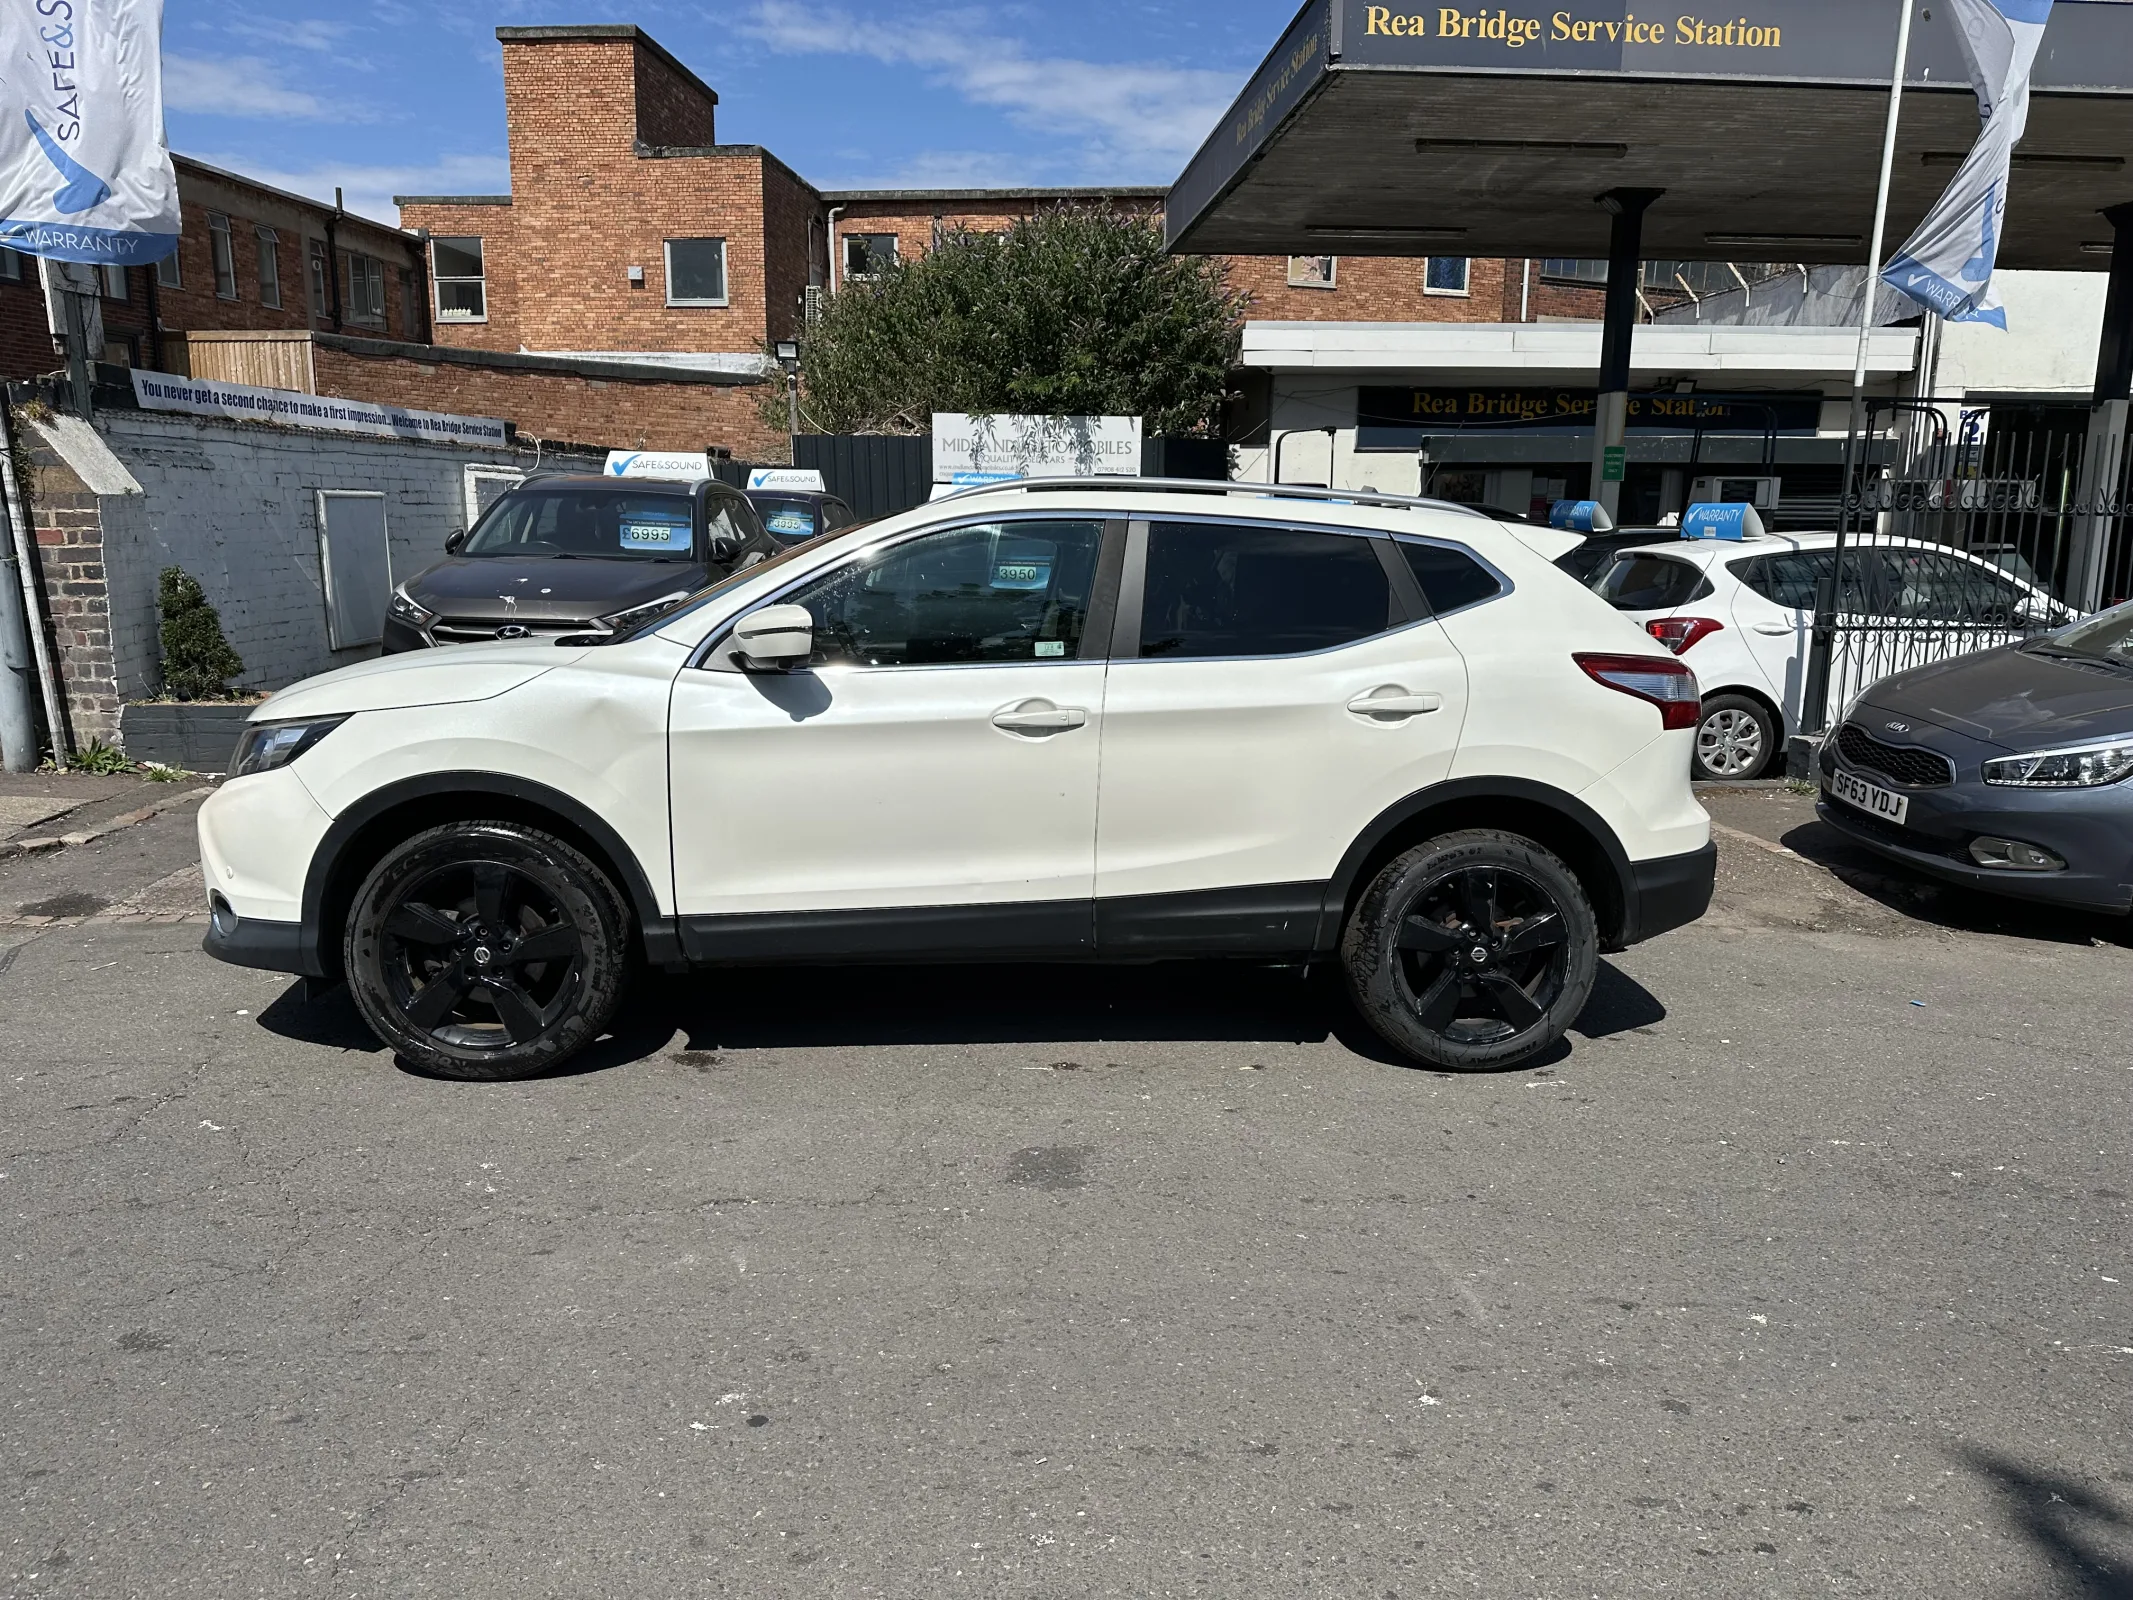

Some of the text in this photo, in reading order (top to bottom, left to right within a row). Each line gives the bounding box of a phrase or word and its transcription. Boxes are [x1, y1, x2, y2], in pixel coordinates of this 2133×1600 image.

[1364, 5, 1782, 48] Rea Bridge Service Station
[1266, 66, 1290, 109] Service
[1290, 33, 1318, 79] Station
[25, 229, 139, 254] WARRANTY
[141, 379, 161, 398] You
[164, 384, 193, 402] never
[195, 389, 212, 404] get
[213, 391, 220, 405] a
[221, 392, 255, 409] second
[256, 395, 289, 413] chance
[289, 400, 299, 414] to
[299, 402, 322, 418] make
[323, 406, 329, 419] a
[329, 405, 347, 420] first
[391, 413, 422, 429] Welcome
[422, 418, 430, 430] to
[430, 418, 441, 432] Rea
[441, 419, 462, 435] Bridge
[462, 422, 482, 437] Service
[483, 424, 502, 438] Station
[1412, 392, 1731, 420] Rea Bridge Sere Staton
[632, 460, 702, 471] SAFE&SOUND
[767, 475, 817, 483] SAFE&SOUND
[1560, 505, 1592, 517] WARRANTY
[1698, 508, 1743, 522] WARRANTY
[621, 527, 670, 541] £6995
[991, 567, 1036, 580] £3950
[1886, 721, 1906, 732] KIA
[1837, 773, 1903, 817] SF63 YDJ
